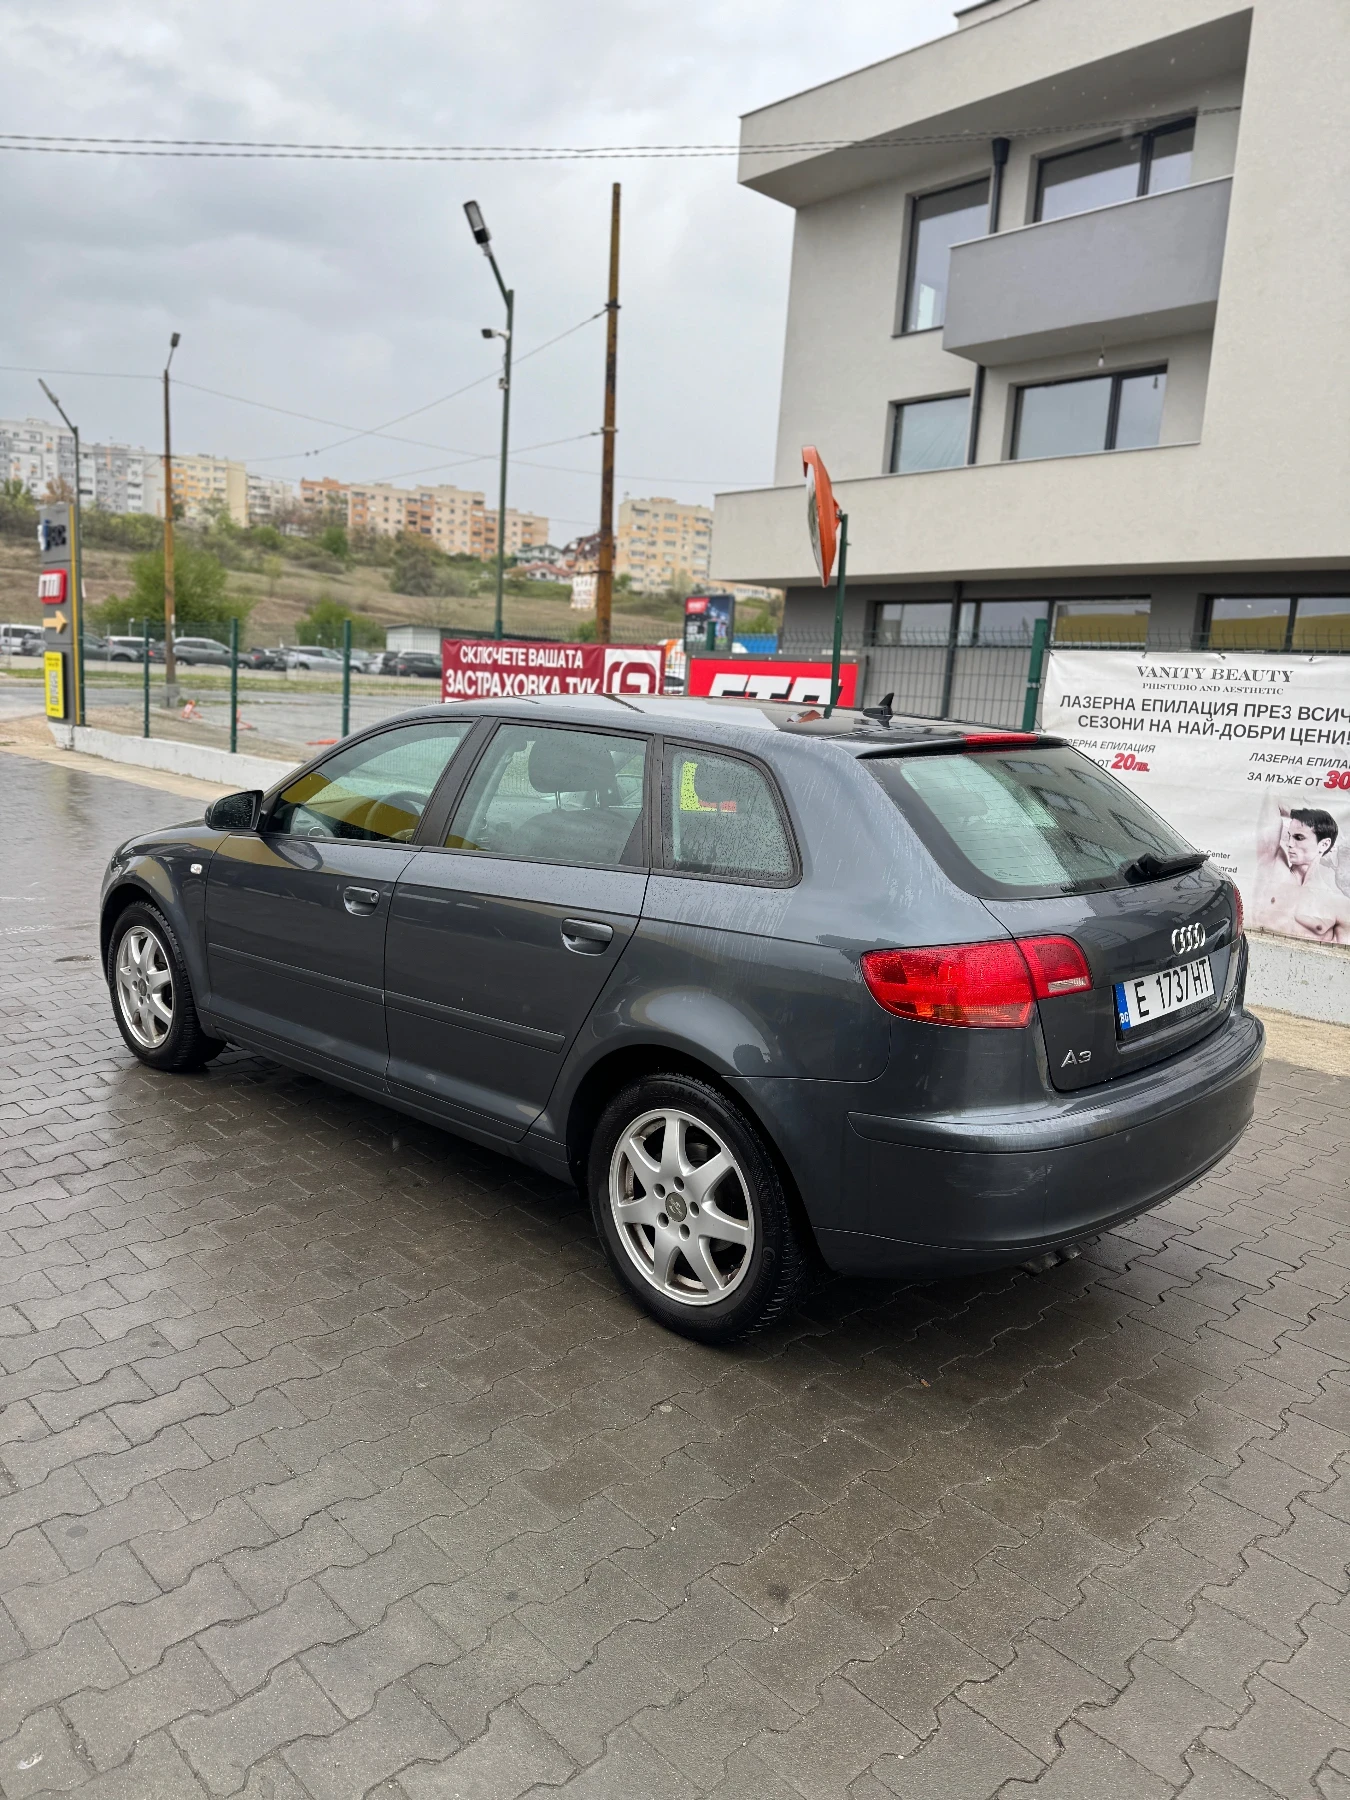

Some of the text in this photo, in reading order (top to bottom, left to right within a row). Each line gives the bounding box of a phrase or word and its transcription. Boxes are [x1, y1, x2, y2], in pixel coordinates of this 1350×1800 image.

[460, 645, 583, 669] СКЛЮЧЕТЕ ВАШАТА
[445, 669, 600, 696] ЗАСТРАХОВКА ТУК
[1137, 666, 1294, 682] VANITY BEAUTY
[1142, 683, 1197, 691] PHISTUDIO
[1223, 686, 1284, 695] AESTHETIC
[1060, 695, 1136, 711] ЛАЗЕРНА
[1141, 699, 1238, 718] ЕПИЛАЦИЯ
[1243, 703, 1292, 719] ПРЕЗ
[1078, 715, 1350, 746] СЕЗОНИ НА НАЙ-ДОБРИ ЦЕНИ!
[1100, 741, 1156, 753] ЕПИЛАЦИЯ
[1249, 753, 1350, 769] ЛАЗЕРНА ЕПИЛА
[1247, 770, 1350, 790] ЗА МЪЖЕ ОТ 30
[1134, 981, 1150, 1017] E
[1156, 965, 1189, 1009] 1737
[1190, 959, 1209, 996] HT
[1119, 1012, 1129, 1024] BG
[1061, 1049, 1091, 1068] A3
